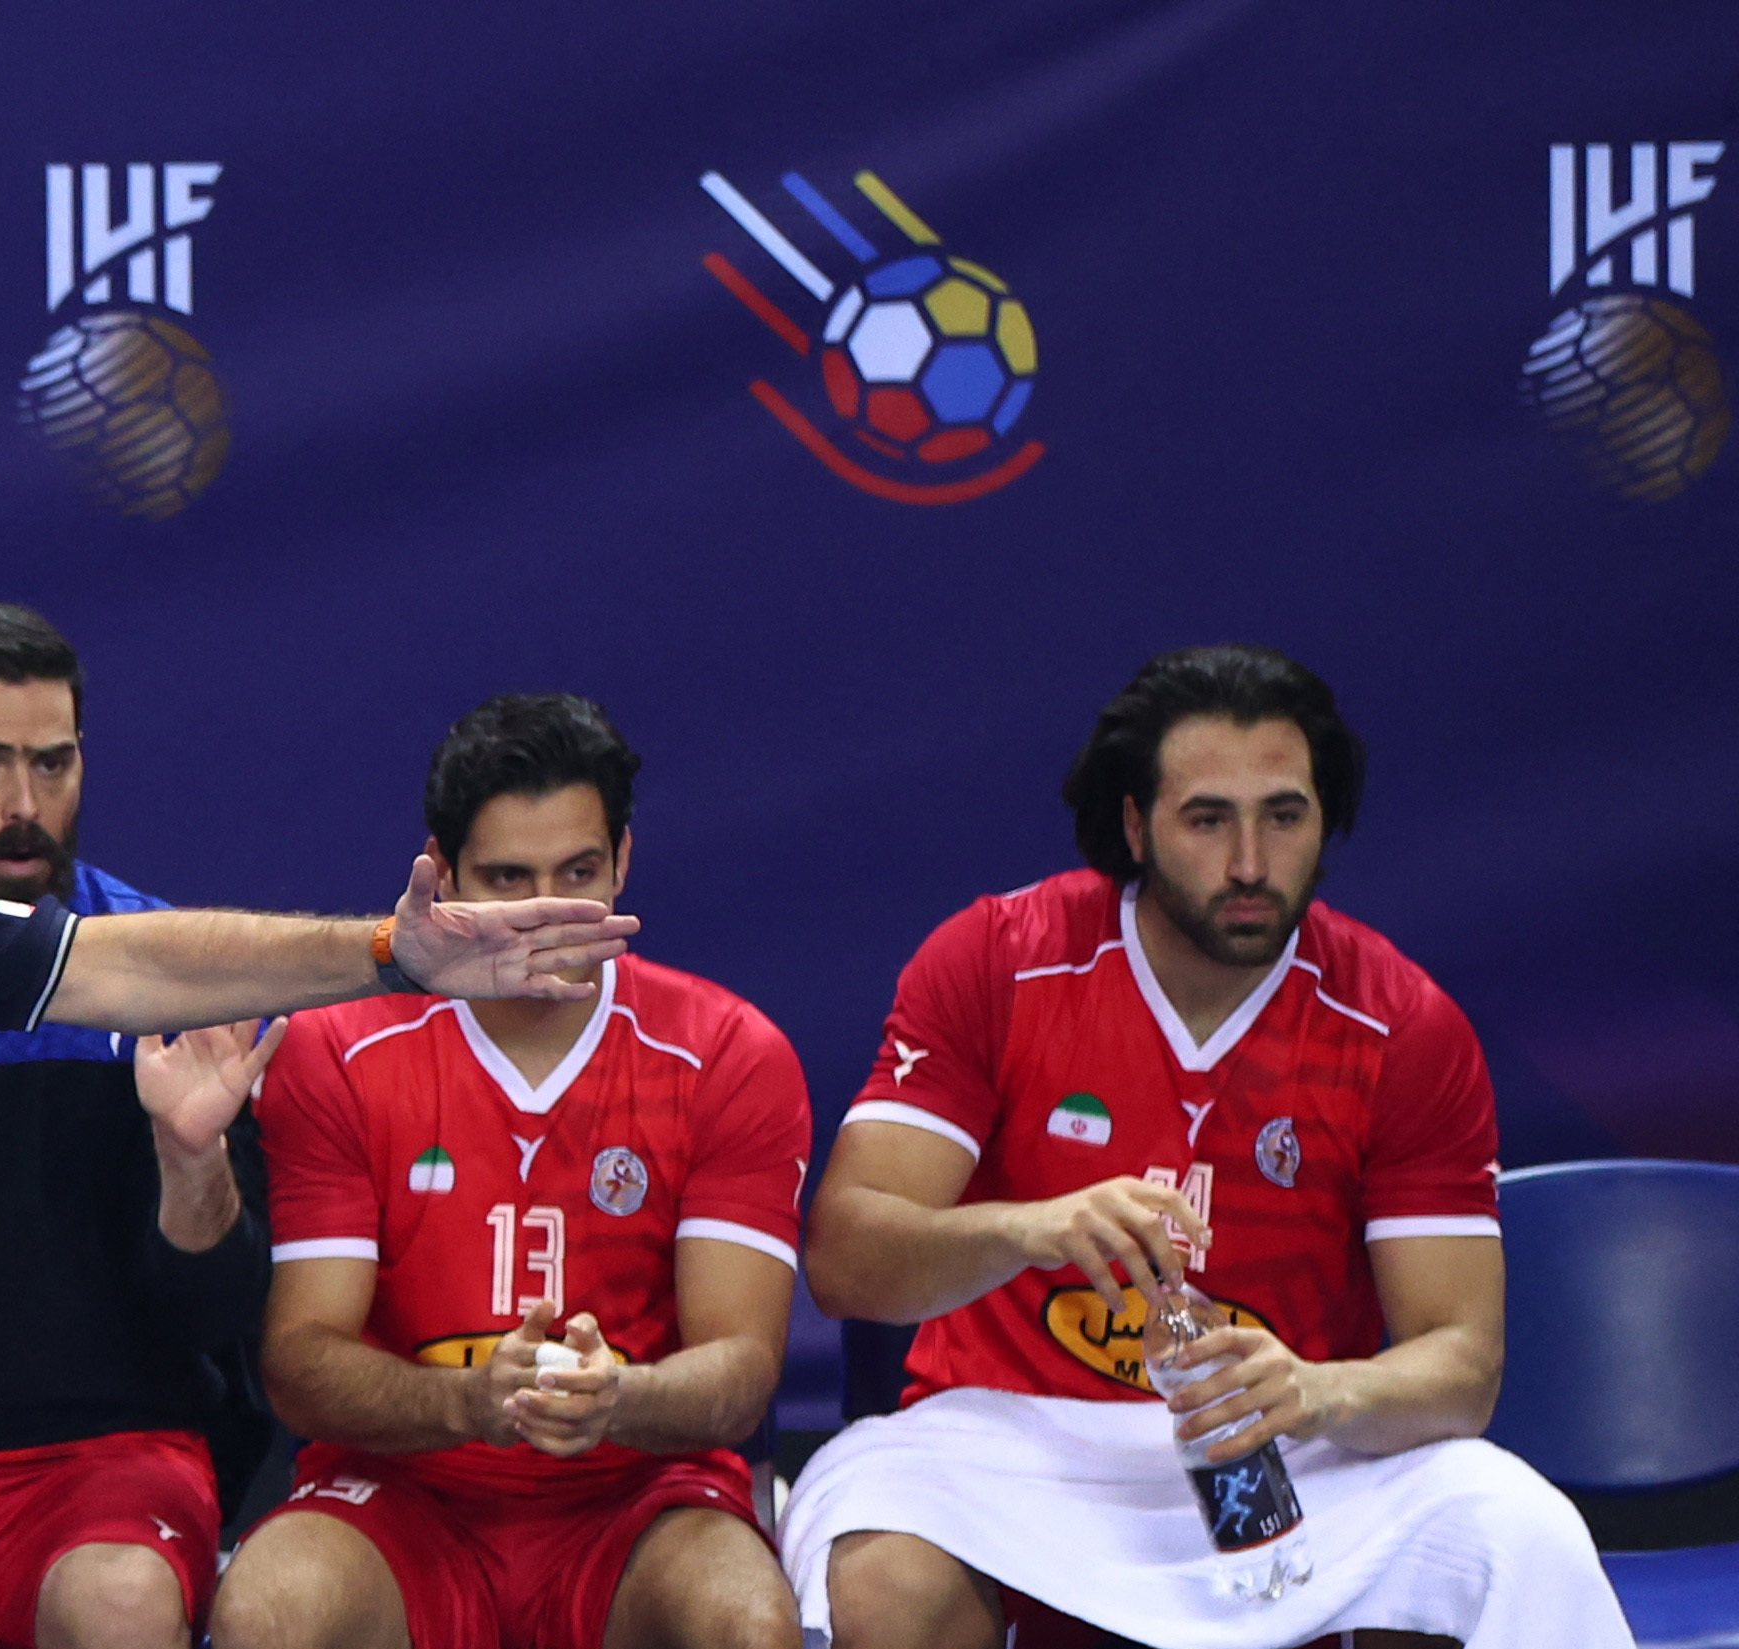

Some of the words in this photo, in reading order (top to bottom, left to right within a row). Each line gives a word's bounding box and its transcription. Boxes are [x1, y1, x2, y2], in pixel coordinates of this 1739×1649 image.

[45, 161, 223, 316] IHF
[1548, 140, 1726, 298] IHF
[486, 1203, 565, 1319] 13
